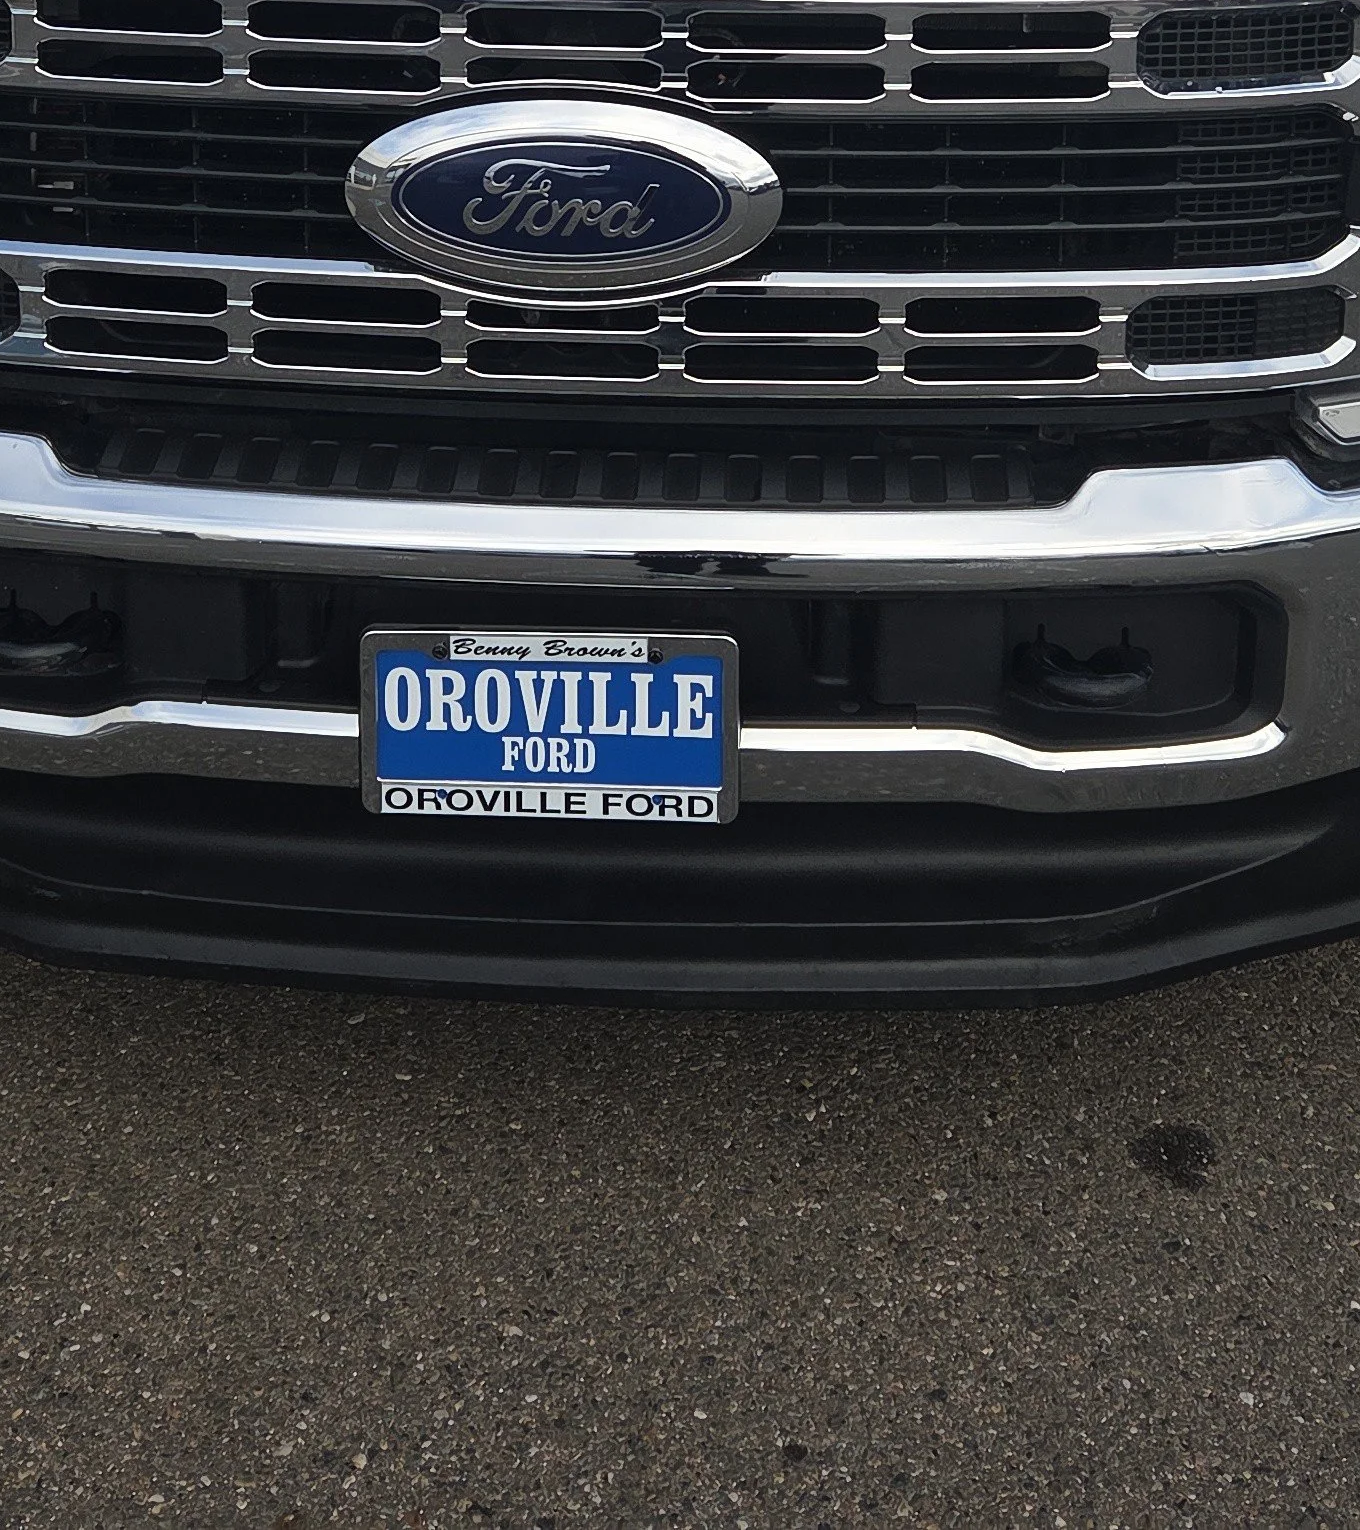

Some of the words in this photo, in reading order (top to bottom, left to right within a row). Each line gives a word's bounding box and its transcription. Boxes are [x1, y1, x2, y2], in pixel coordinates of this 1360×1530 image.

[463, 158, 660, 239] Ford
[452, 638, 532, 660] Benny
[540, 640, 646, 658] Brown's
[384, 666, 714, 738] OROVILLE
[502, 736, 597, 773] FORD
[384, 787, 587, 815] OROVILLE
[602, 792, 714, 818] FORD
